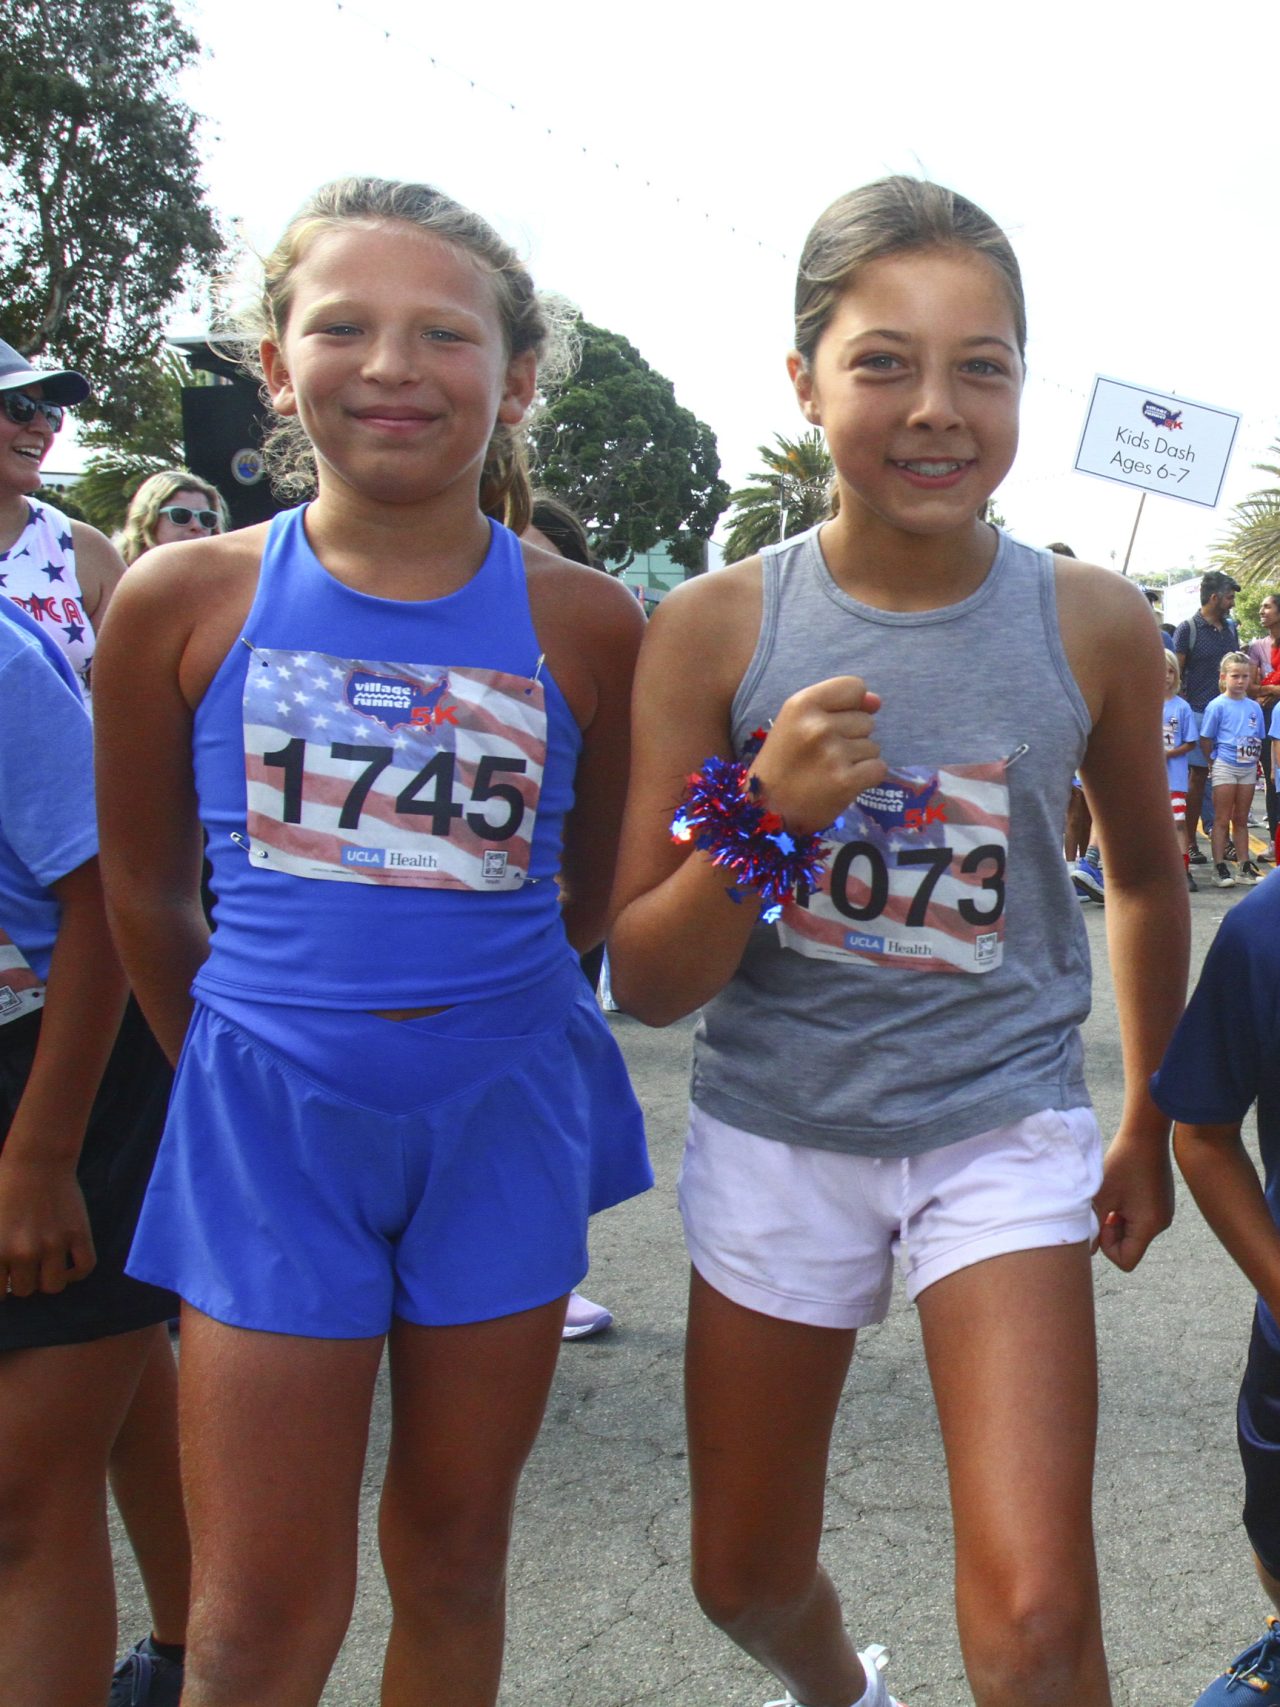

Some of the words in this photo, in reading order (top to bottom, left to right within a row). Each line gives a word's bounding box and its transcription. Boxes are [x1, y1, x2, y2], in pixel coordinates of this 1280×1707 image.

[1115, 426, 1150, 450] Kids
[1154, 437, 1196, 463] Dash
[1110, 450, 1151, 474] Ages
[1156, 464, 1190, 484] 6-7
[355, 683, 411, 694] village
[354, 697, 411, 708] runner
[411, 705, 460, 726] 5K
[263, 737, 527, 842] 1745
[904, 803, 948, 829] 5K
[346, 850, 380, 864] UCLA
[389, 852, 438, 869] Health
[849, 936, 881, 950] UCLA
[888, 940, 932, 956] Health
